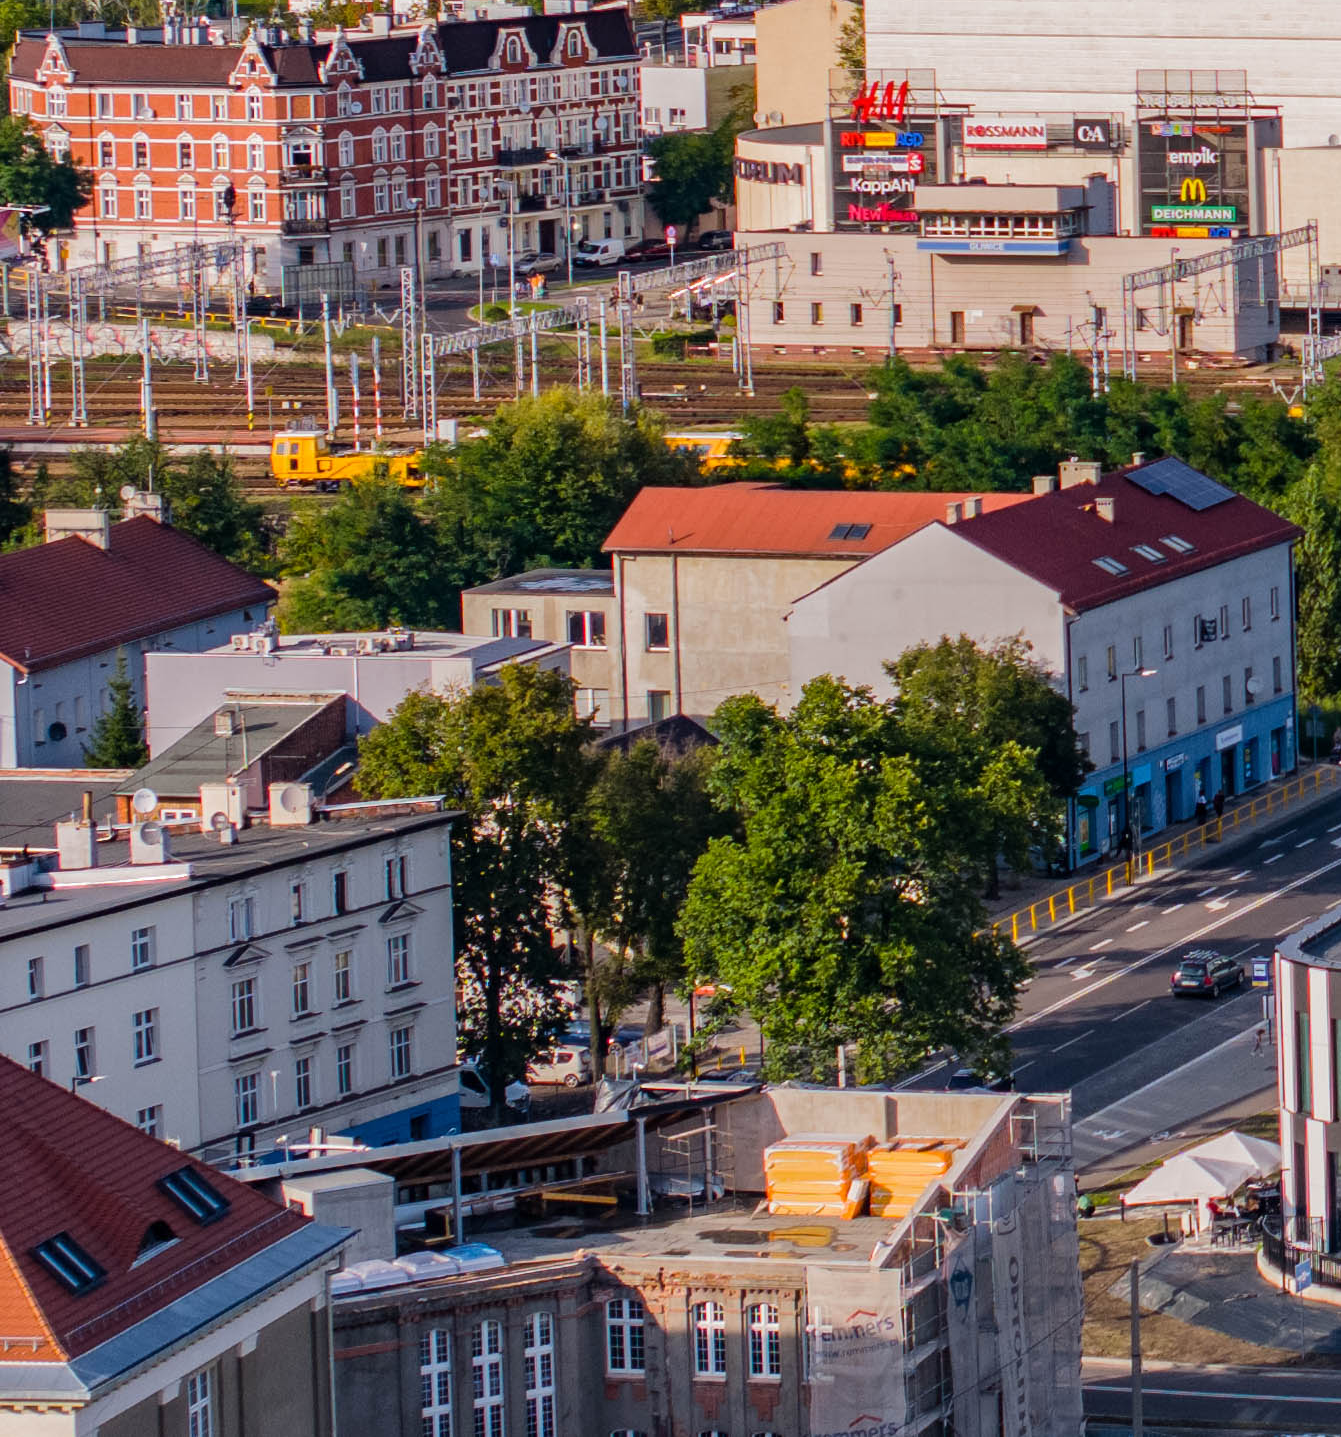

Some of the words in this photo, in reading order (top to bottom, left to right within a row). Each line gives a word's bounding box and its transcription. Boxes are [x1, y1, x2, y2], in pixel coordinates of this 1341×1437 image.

[897, 131, 925, 147] AGD
[966, 125, 1044, 138] ROSSMANN
[1077, 125, 1105, 142] C&A
[1168, 146, 1219, 167] empik
[851, 177, 916, 194] KappAhl
[1153, 208, 1233, 220] DEICHMANN
